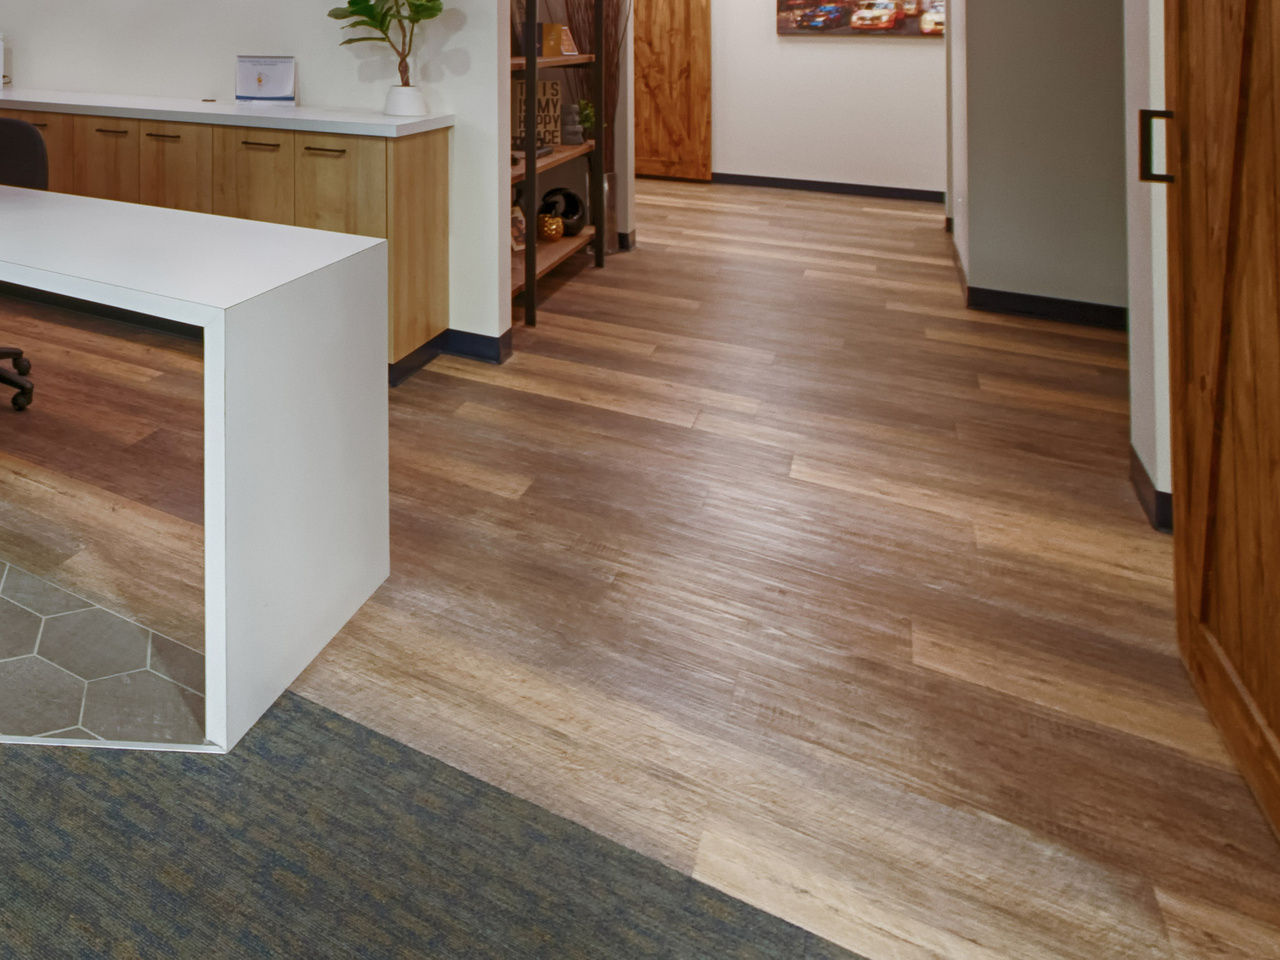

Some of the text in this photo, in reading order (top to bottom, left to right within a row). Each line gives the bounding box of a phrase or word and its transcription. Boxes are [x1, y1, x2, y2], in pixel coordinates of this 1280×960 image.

[518, 82, 559, 97] TIS
[537, 98, 559, 114] MY
[518, 114, 560, 129] HPPY
[519, 129, 559, 145] ACE
